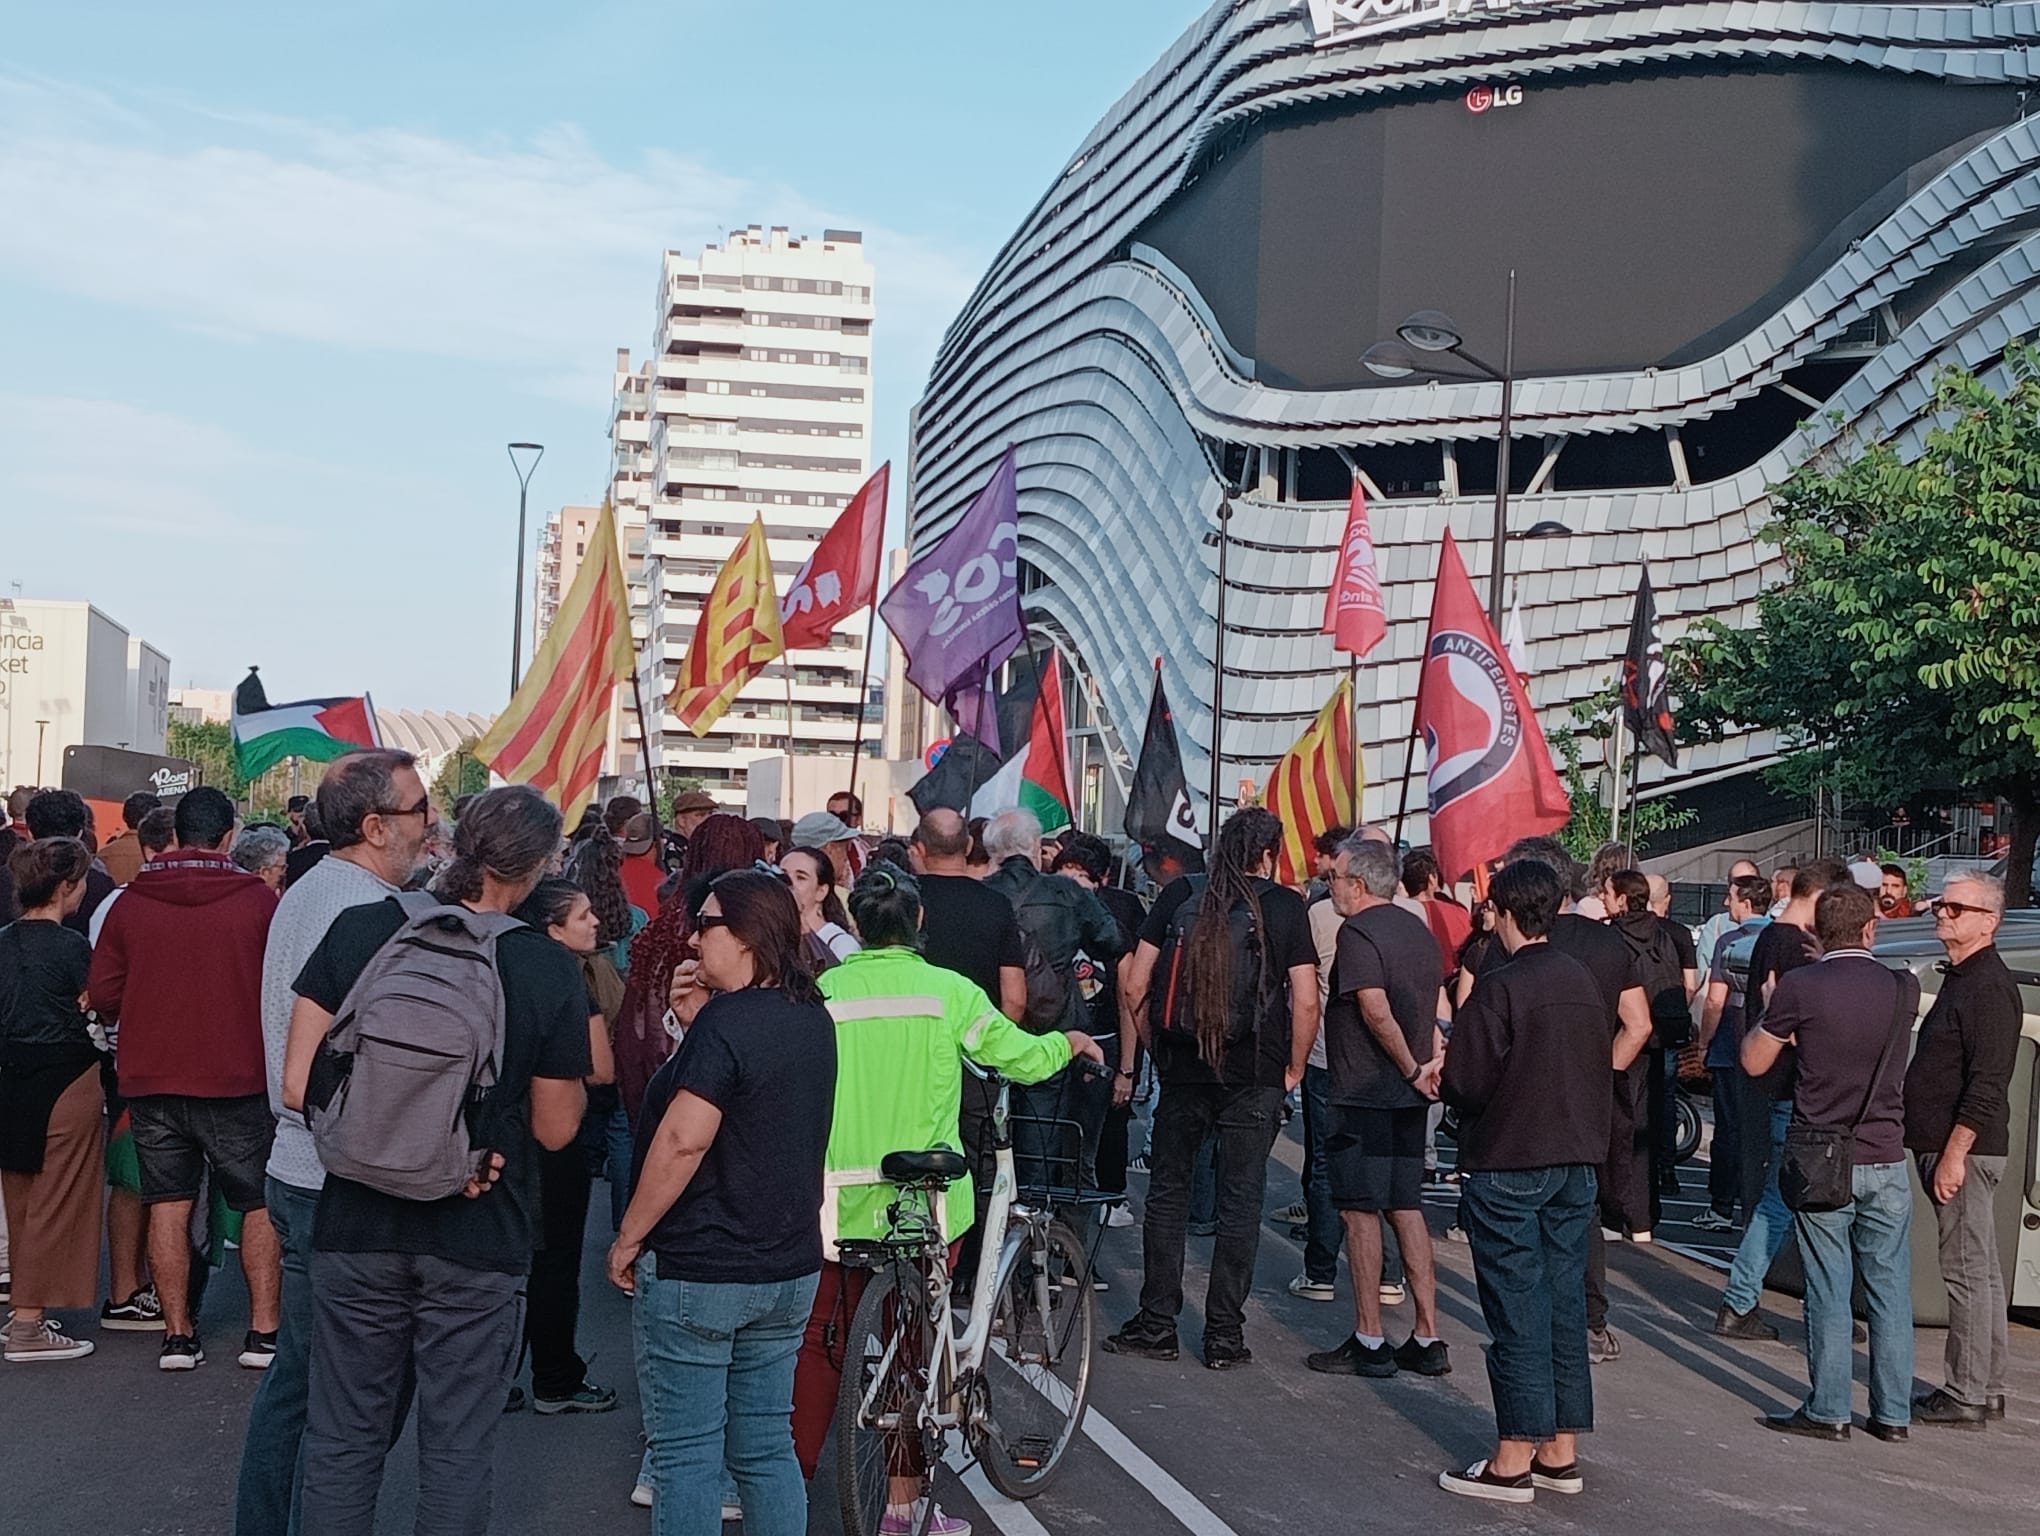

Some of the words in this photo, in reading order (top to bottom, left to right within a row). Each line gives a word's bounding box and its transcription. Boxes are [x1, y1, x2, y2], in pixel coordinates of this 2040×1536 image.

[1493, 85, 1523, 107] LG
[0, 629, 43, 650] ncia
[1443, 638, 1518, 747] ANTIFEIXISTES
